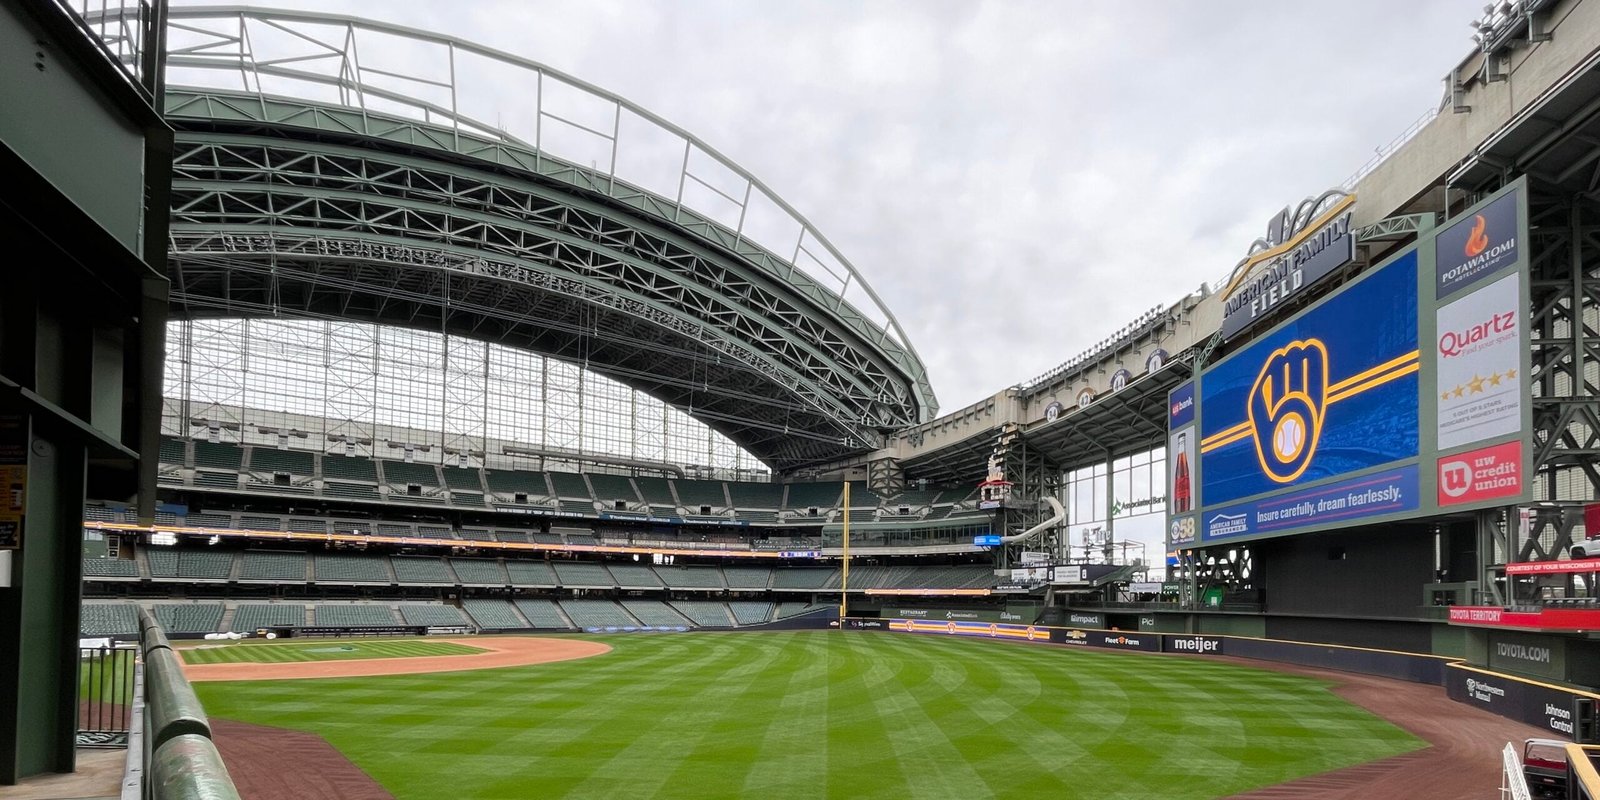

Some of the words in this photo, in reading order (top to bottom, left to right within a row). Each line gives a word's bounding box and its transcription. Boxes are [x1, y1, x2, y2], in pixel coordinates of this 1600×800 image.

[1224, 261, 1288, 318] AMERICAN
[1292, 212, 1352, 270] FAMILY
[1442, 238, 1515, 282] POTAWATOMI
[1251, 269, 1303, 318] FIELD
[1439, 311, 1515, 358] Quartz
[1179, 396, 1193, 410] bank
[1475, 456, 1496, 468] uw
[1475, 462, 1516, 479] credit
[1475, 476, 1517, 491] union
[1257, 511, 1279, 523] Insure
[1280, 503, 1317, 519] carefully,
[1318, 496, 1346, 512] dream
[1348, 485, 1402, 507] fearlessly.
[1179, 517, 1195, 539] 58
[1210, 521, 1230, 530] AMERICAN
[1231, 518, 1246, 526] FAMILY
[1076, 614, 1098, 624] impact
[1450, 609, 1469, 620] TOYOTA
[1470, 609, 1501, 621] TERRITORY
[1105, 636, 1119, 644] Fleet
[1124, 638, 1140, 646] Farm
[1174, 637, 1218, 652] meijer
[1497, 642, 1550, 663] TOYOTA.COM
[1475, 681, 1504, 697] Northwestern
[1544, 703, 1571, 720] Johnson
